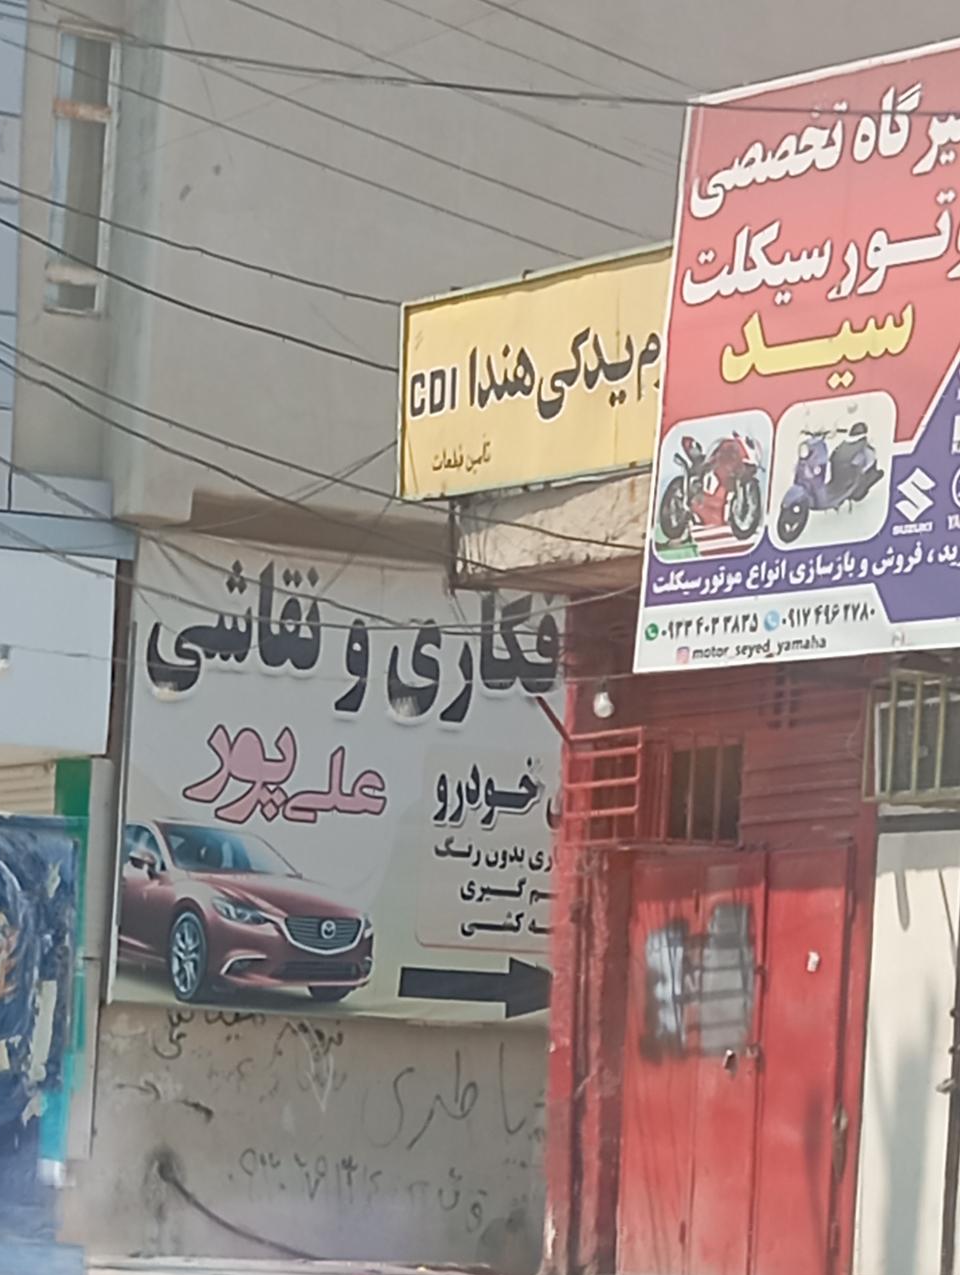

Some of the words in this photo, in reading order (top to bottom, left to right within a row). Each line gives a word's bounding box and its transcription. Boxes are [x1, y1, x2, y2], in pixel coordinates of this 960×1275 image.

[691, 101, 848, 218] تخصصی
[469, 344, 535, 408] هندا
[537, 327, 633, 419] یدکی
[721, 304, 915, 389] سید
[410, 367, 457, 417] CDI
[745, 558, 786, 589] انواع
[789, 550, 855, 584] بازسازی
[857, 558, 869, 578] و
[872, 541, 923, 575] فروش
[146, 560, 321, 694] نقاشی
[386, 590, 561, 722] فکاری
[692, 635, 827, 660] motor_seyed_yamaha
[335, 617, 370, 711] و
[433, 757, 538, 826] خودرو
[485, 846, 525, 869] بدون
